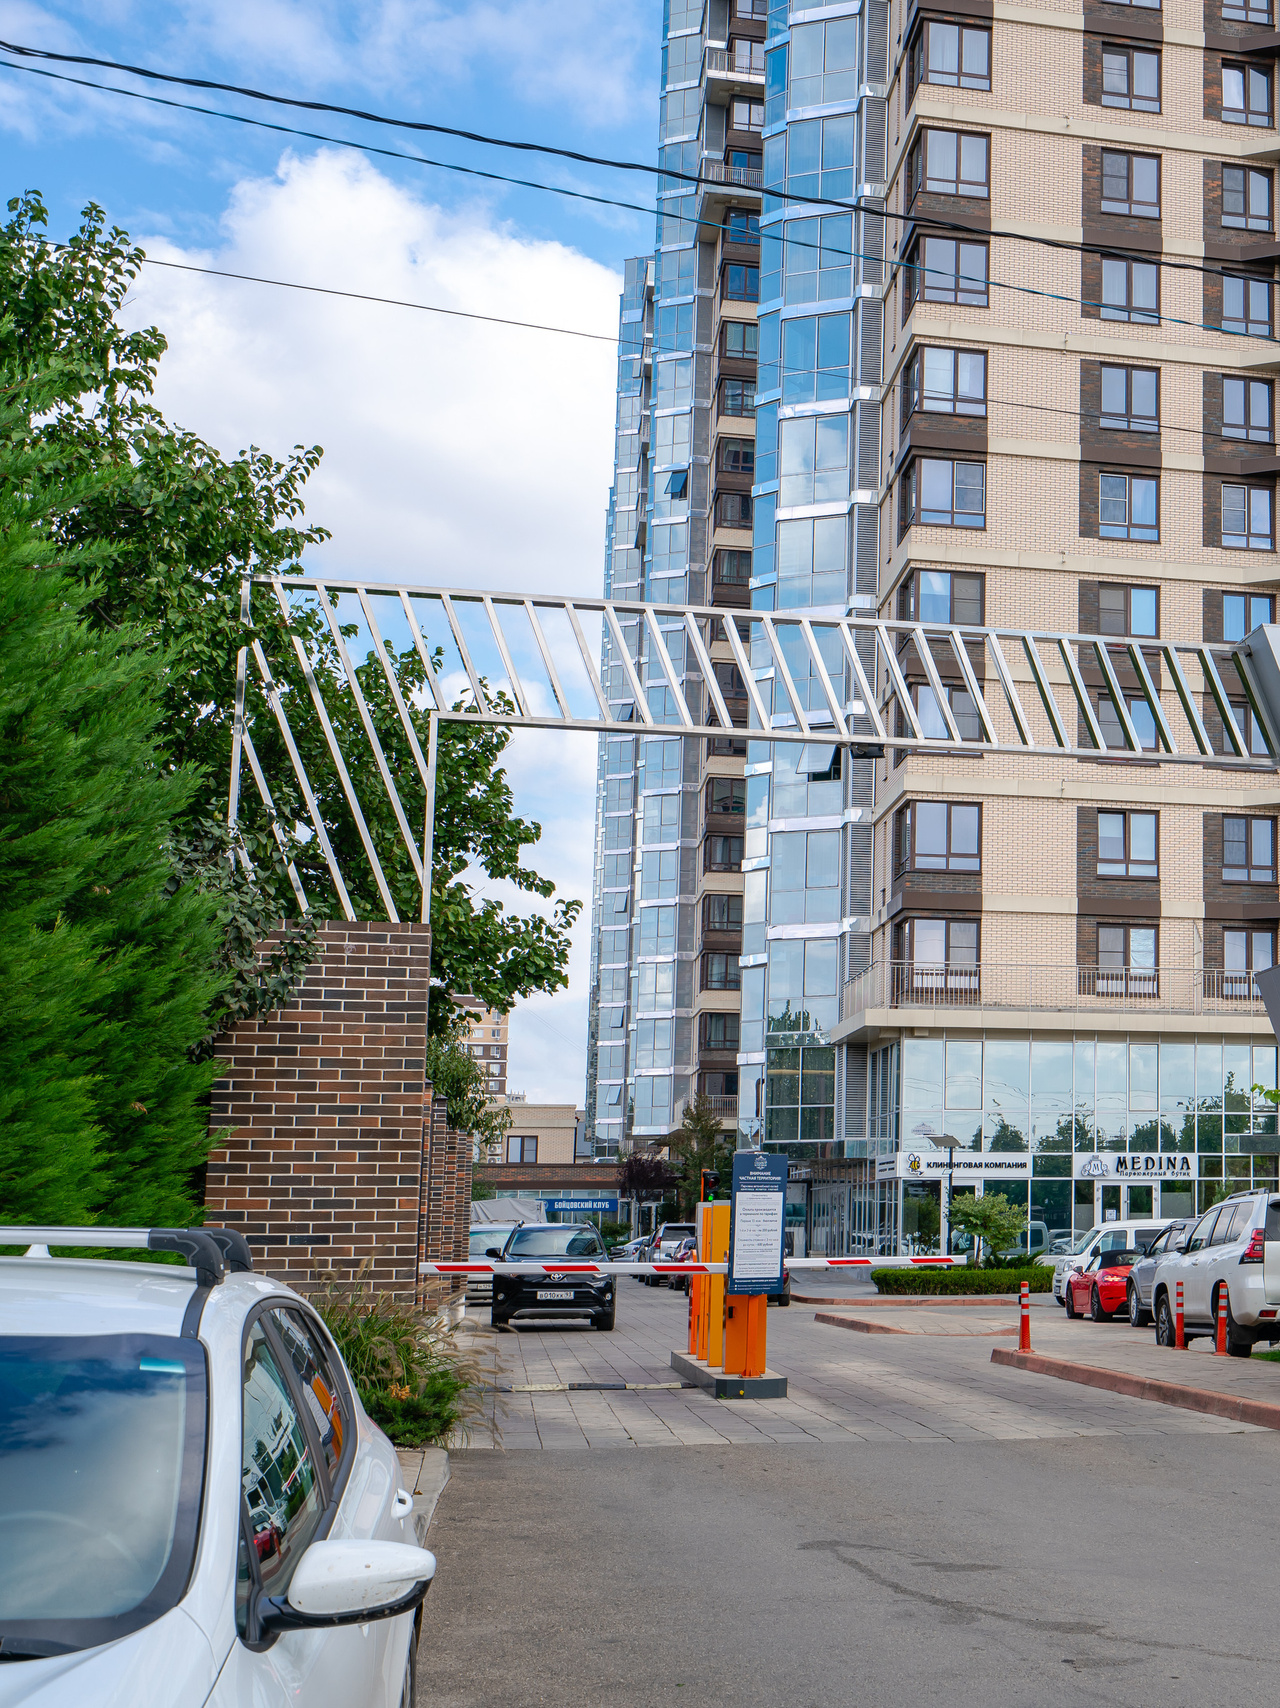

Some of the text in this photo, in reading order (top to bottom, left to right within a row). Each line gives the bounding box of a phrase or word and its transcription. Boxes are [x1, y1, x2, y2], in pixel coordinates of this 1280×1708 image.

[926, 1161, 1027, 1169] КЛИННГОВАЯ КОМПАНИЯ
[1116, 1156, 1191, 1172] MEDINA
[554, 1200, 609, 1210] БОЙЦОВСКИЙ КЛУБ
